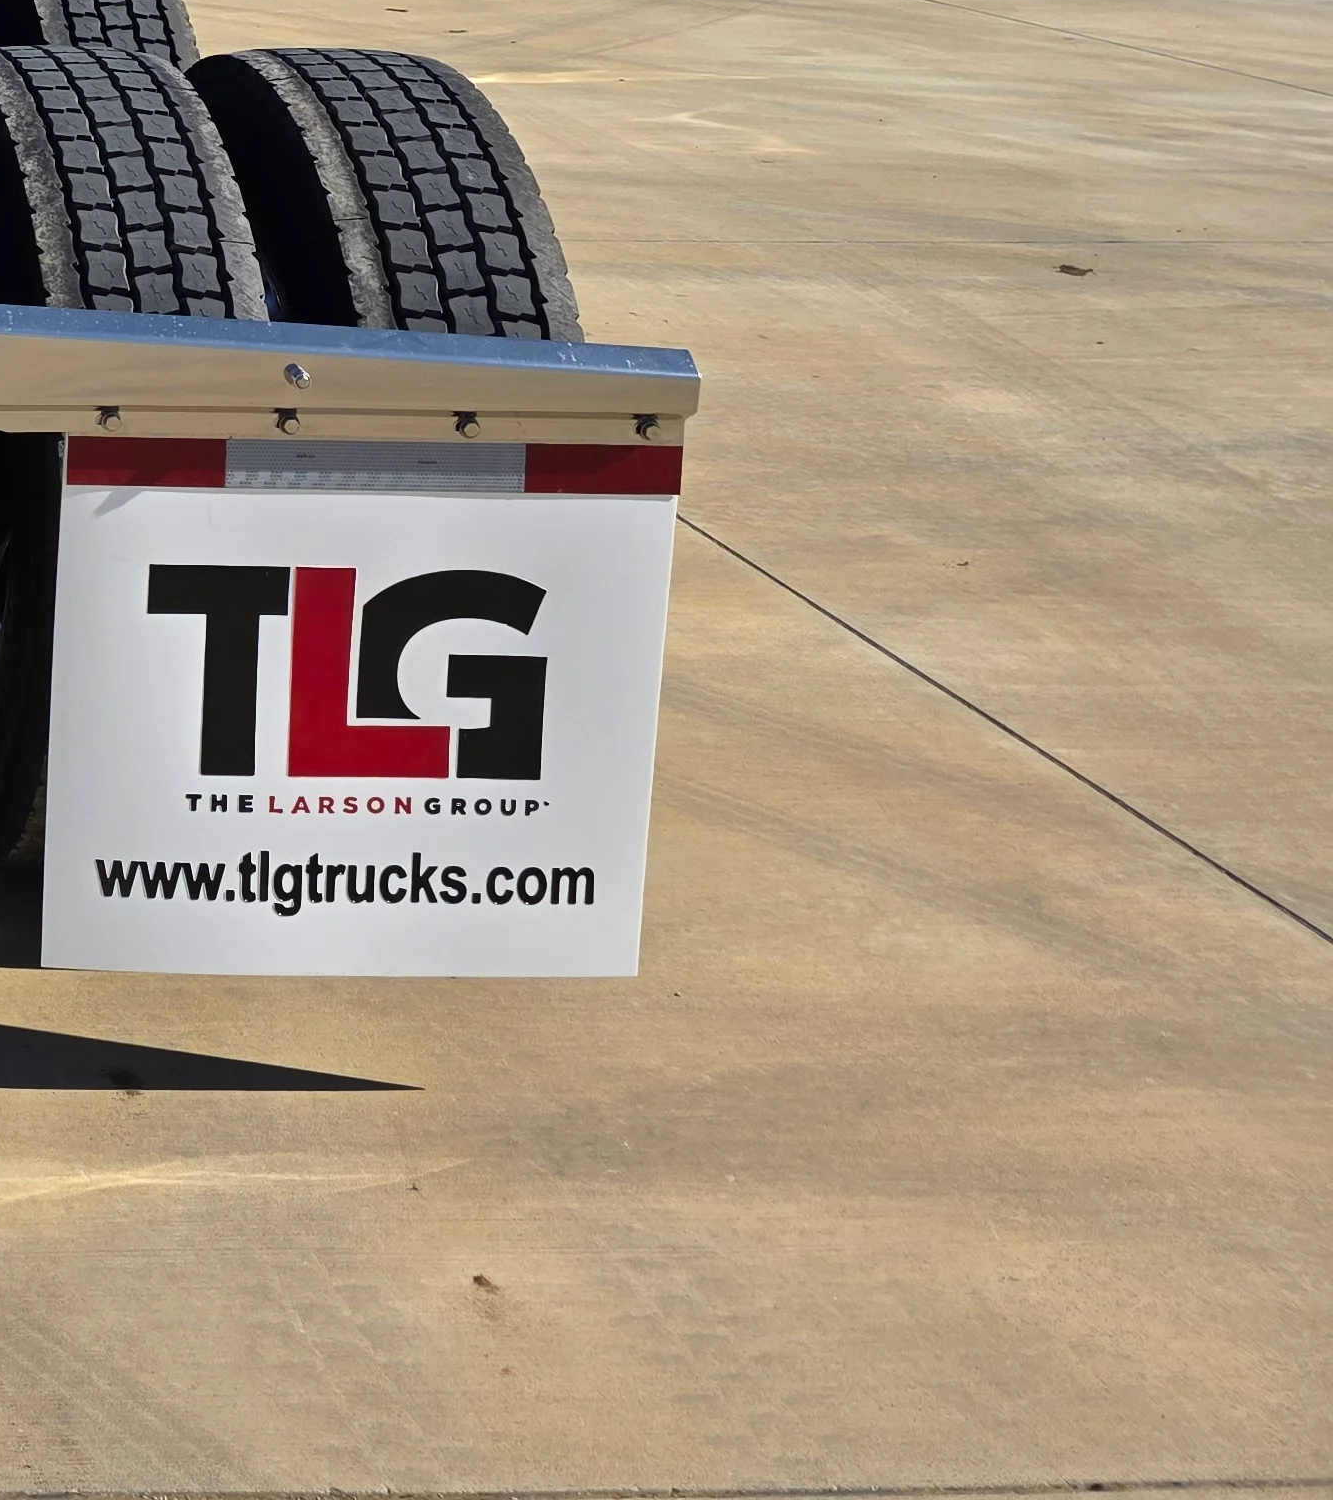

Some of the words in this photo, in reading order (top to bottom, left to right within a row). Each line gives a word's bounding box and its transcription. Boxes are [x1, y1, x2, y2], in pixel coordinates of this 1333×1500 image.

[147, 564, 547, 780] TLG
[186, 794, 253, 812] THE
[269, 796, 411, 814] LARSON
[424, 798, 539, 816] GROUP
[95, 851, 594, 916] www.tlgtrucks.com
